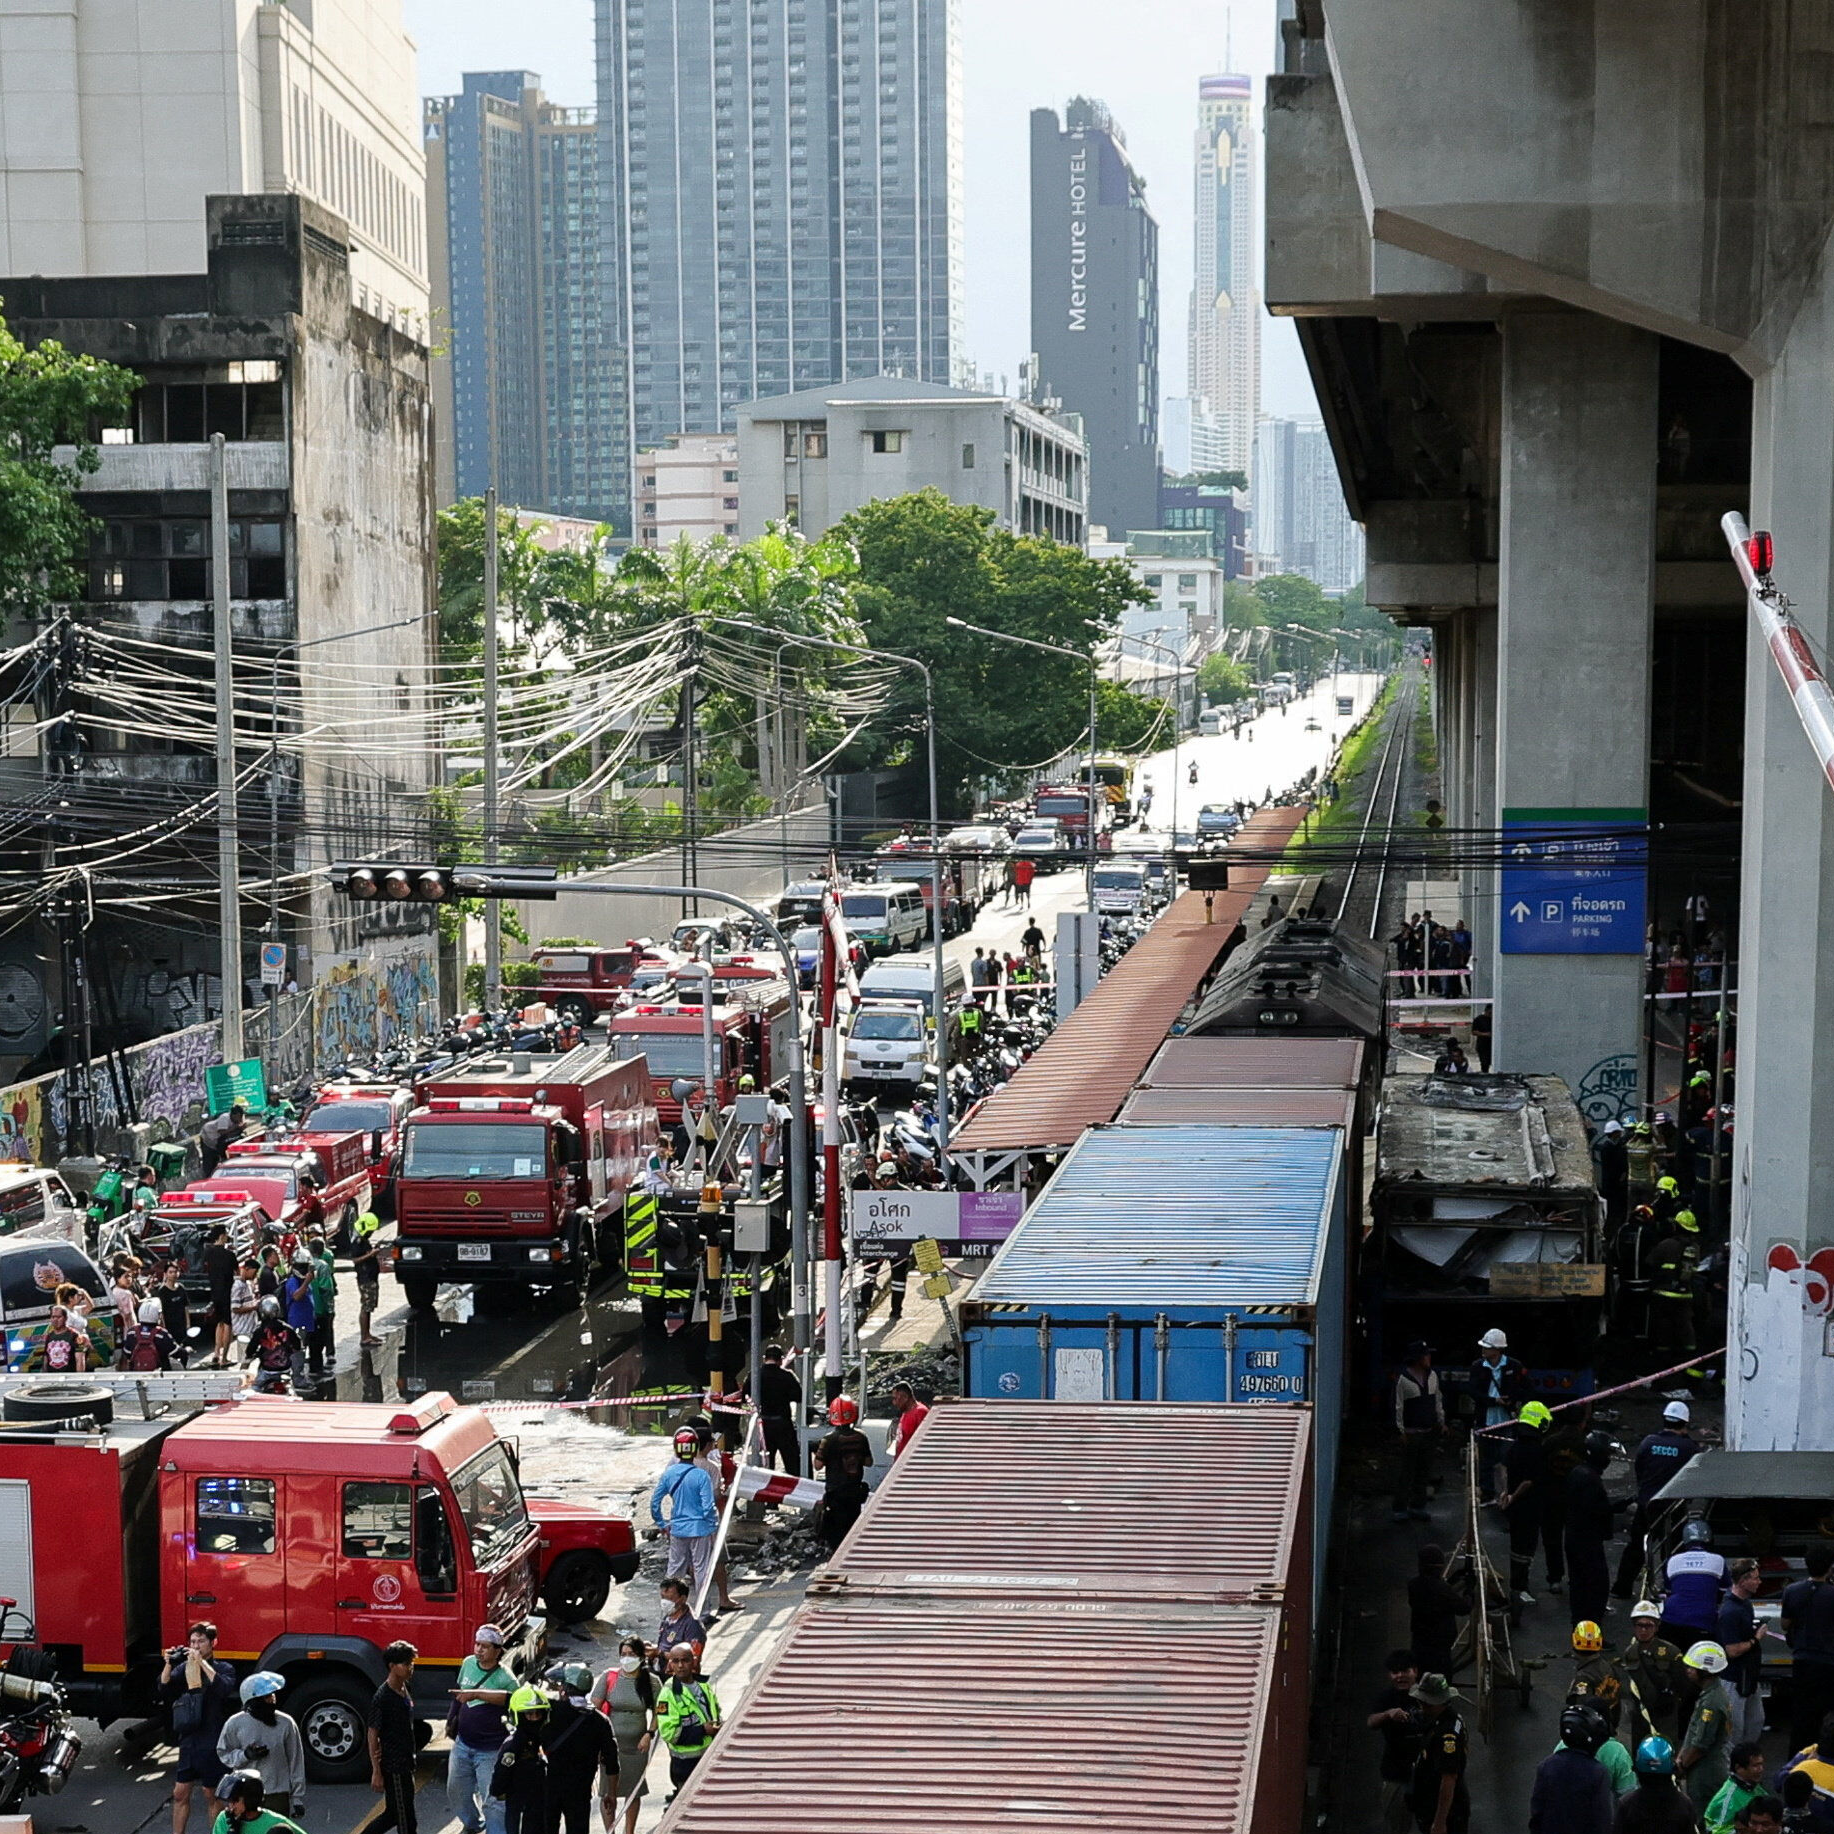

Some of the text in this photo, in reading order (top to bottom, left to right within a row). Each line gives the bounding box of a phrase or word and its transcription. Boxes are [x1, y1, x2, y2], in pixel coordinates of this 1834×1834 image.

[1069, 147, 1086, 332] Mercure HOTEL
[1571, 892, 1626, 911] ที่จอดรถ
[1572, 914, 1613, 923] PARKING
[868, 1197, 910, 1218] อโศก
[868, 1220, 903, 1233] Asok
[975, 1203, 1007, 1212] Inbound
[859, 1244, 988, 1257] Interchange MRT
[798, 1285, 806, 1297] 3
